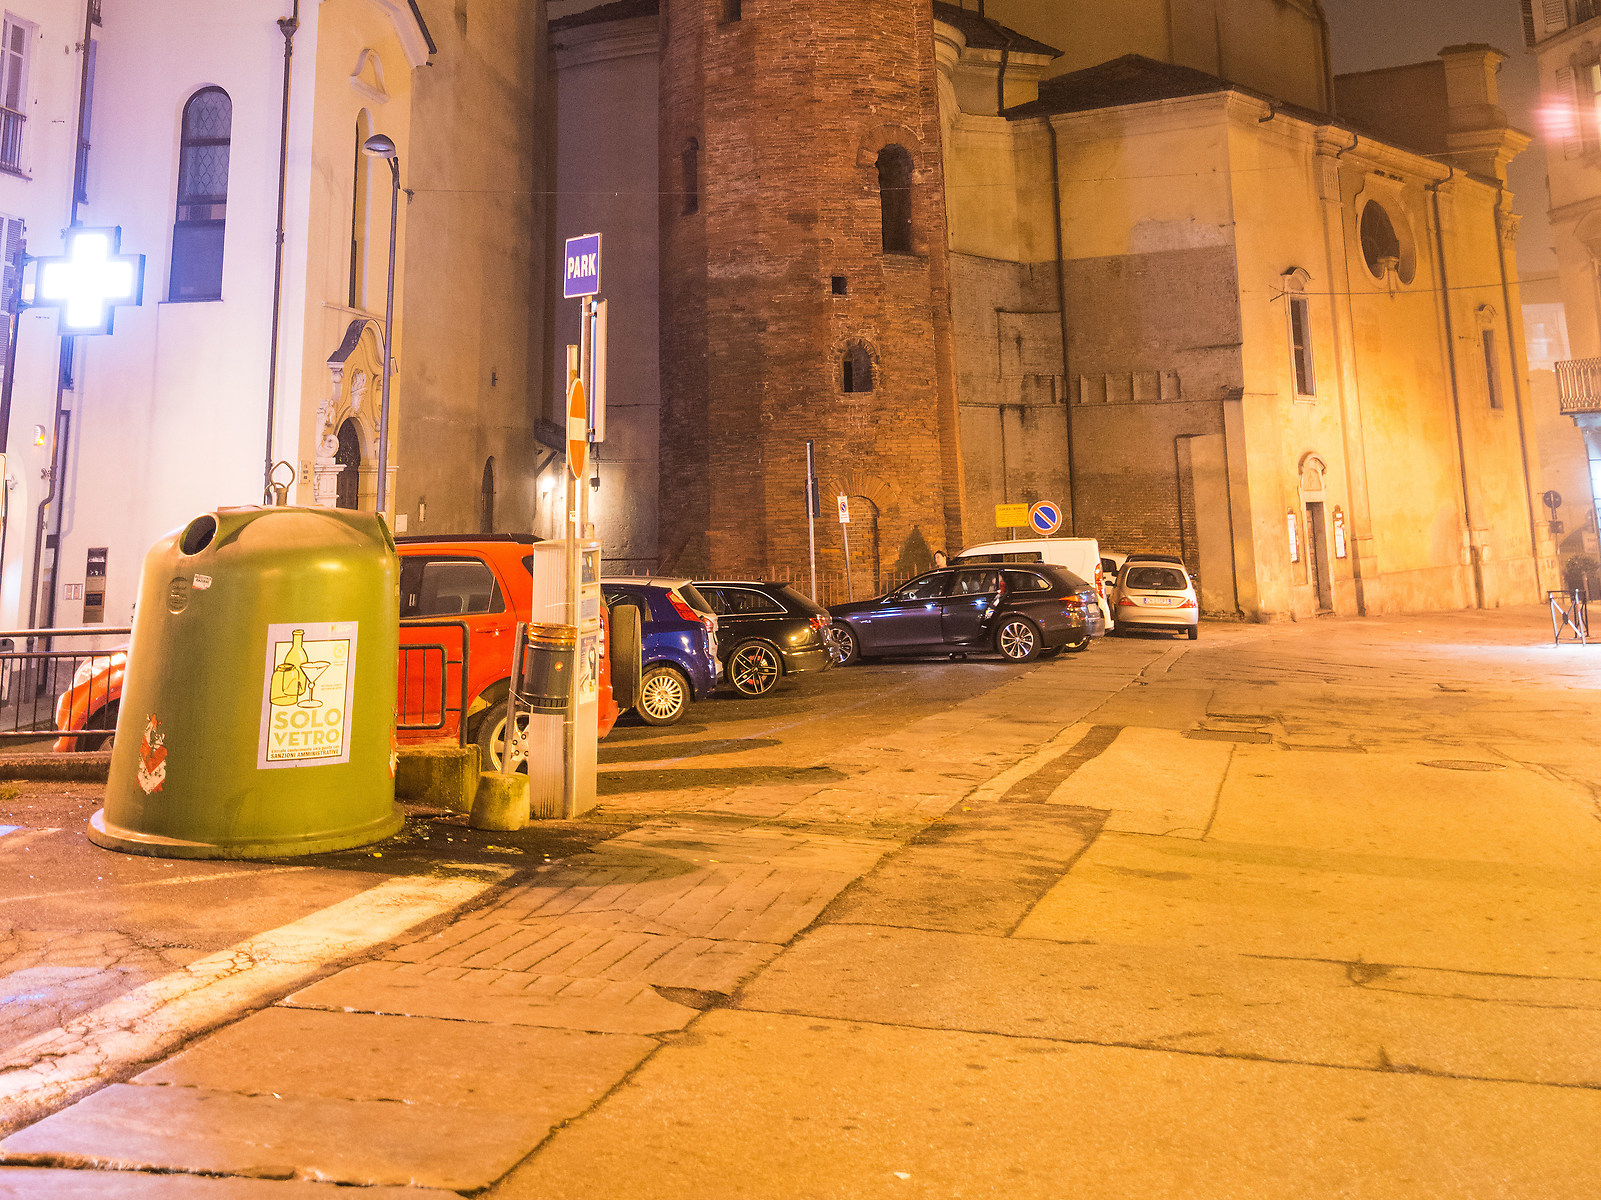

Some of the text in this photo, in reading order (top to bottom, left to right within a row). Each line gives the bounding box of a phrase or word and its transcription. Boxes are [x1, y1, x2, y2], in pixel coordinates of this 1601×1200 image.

[567, 253, 597, 280] PARK
[273, 708, 342, 730] SOLO
[273, 728, 340, 747] VETRO
